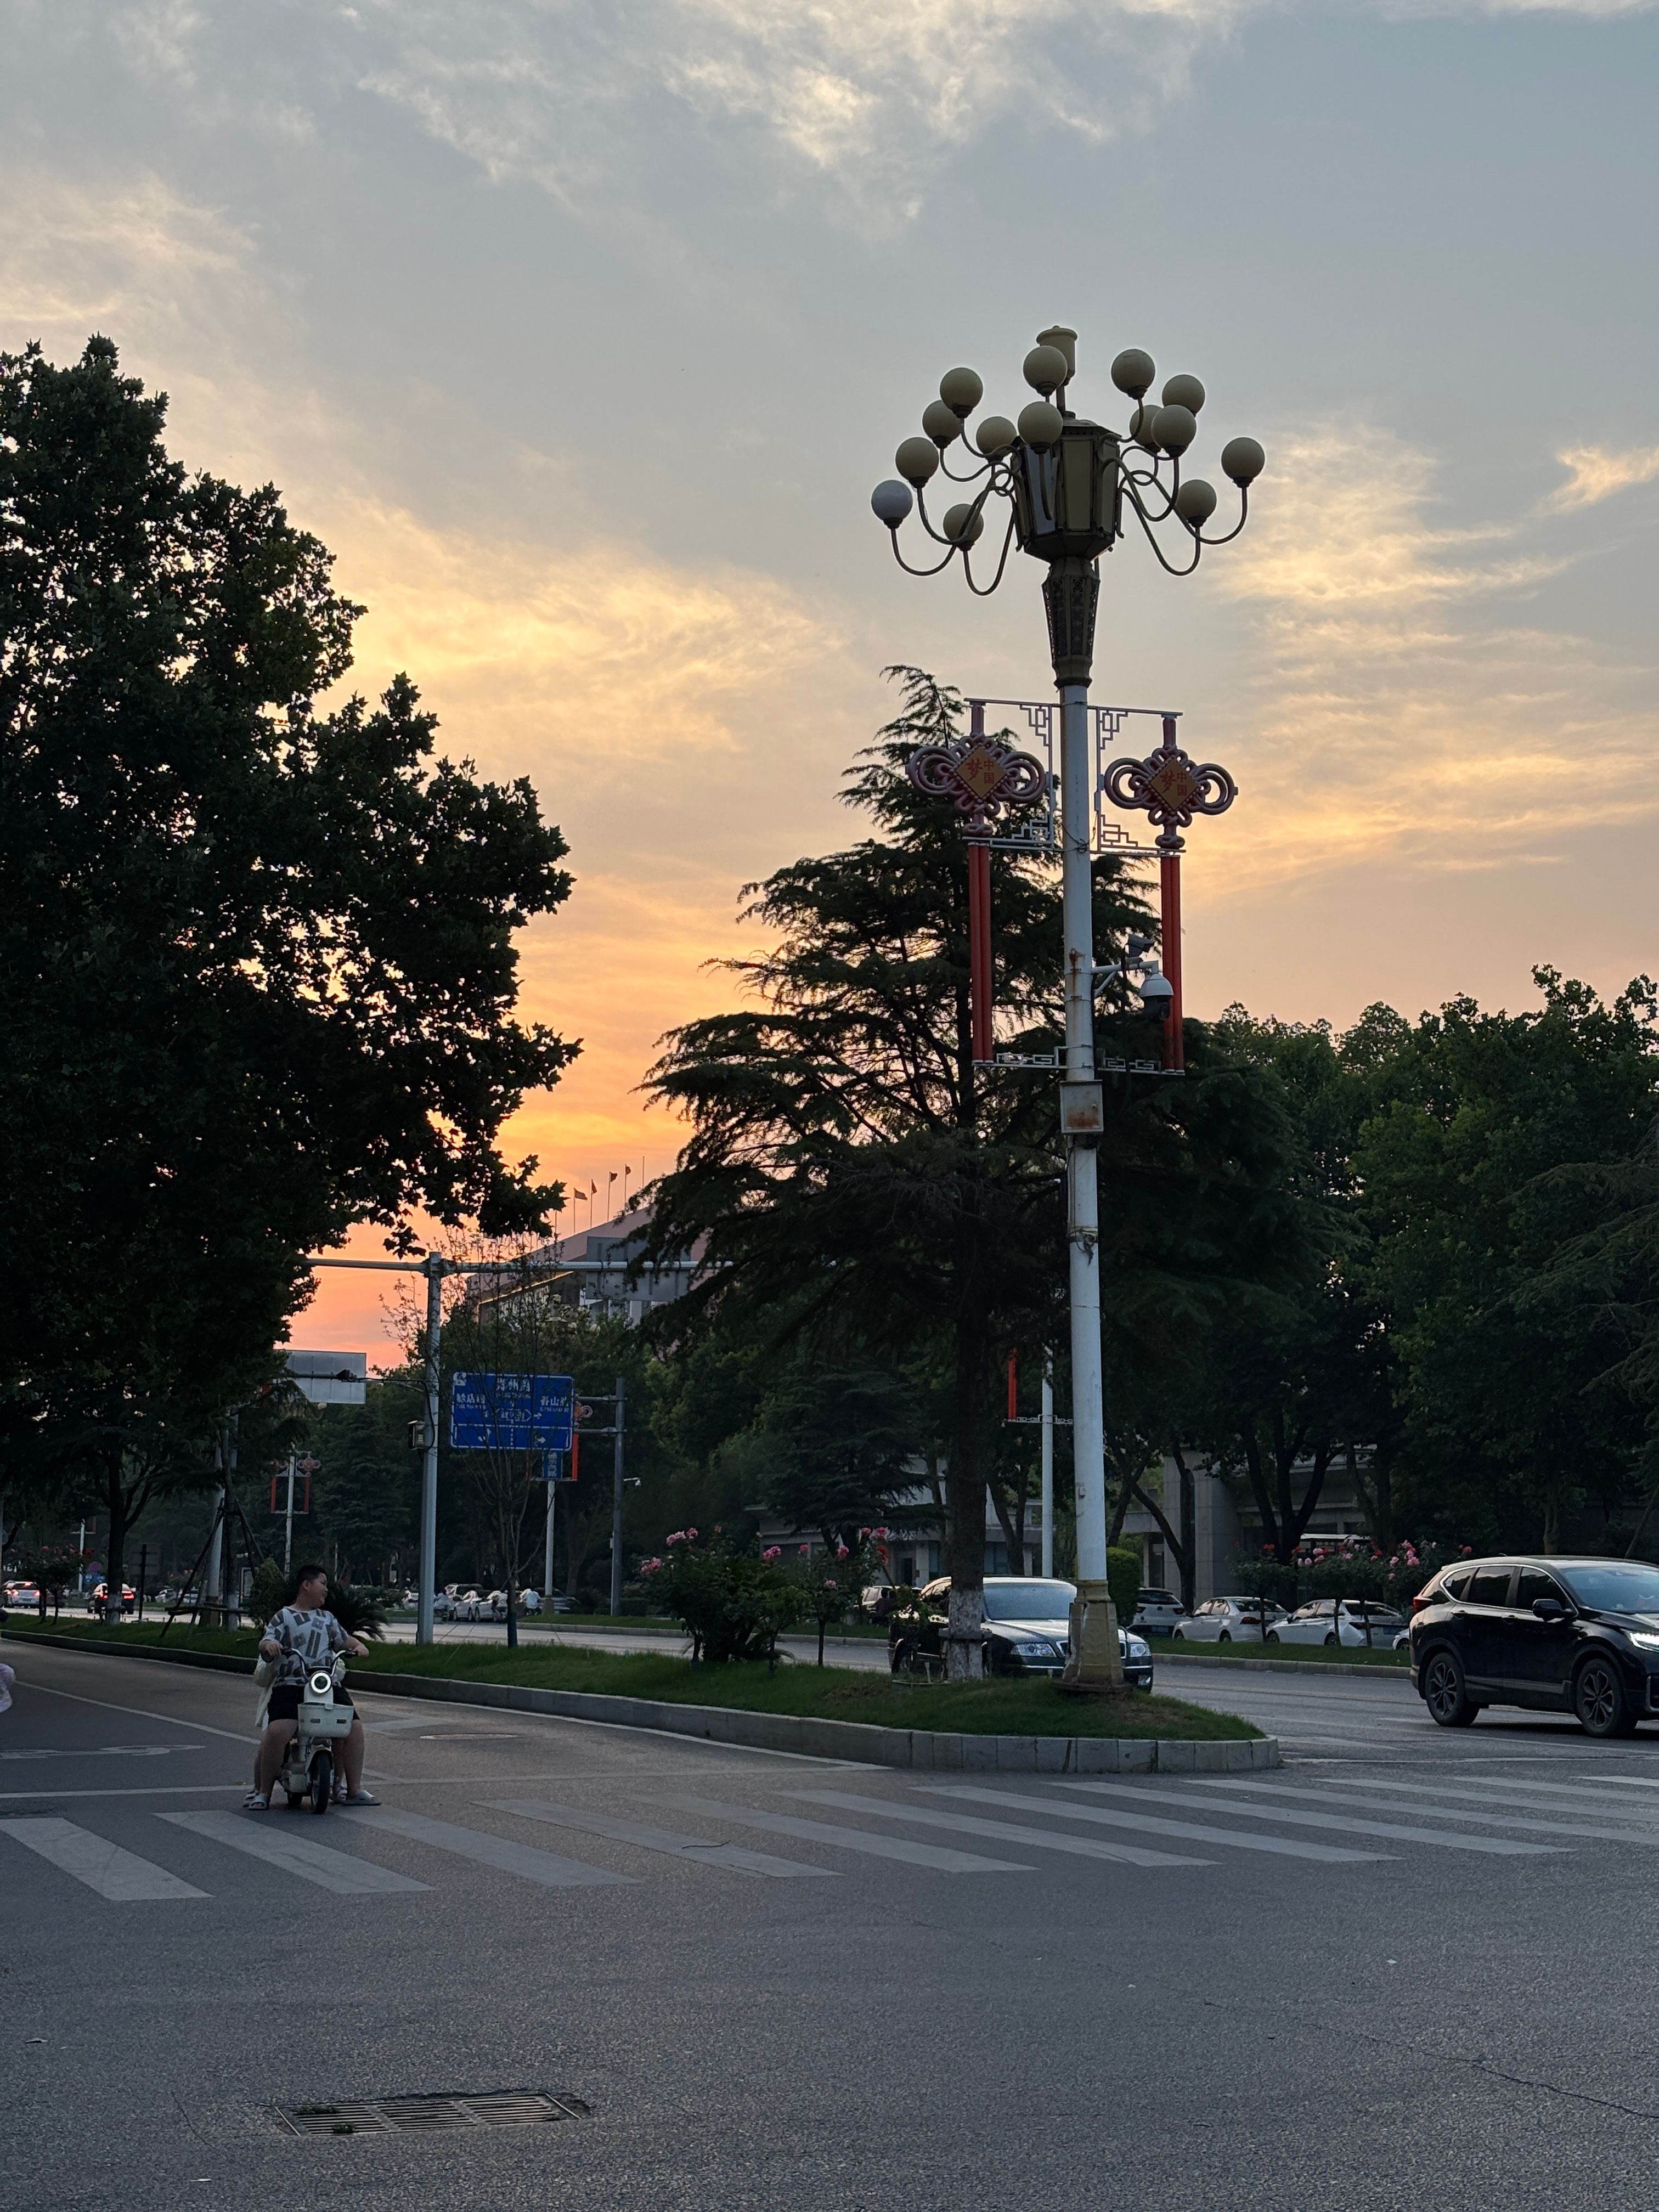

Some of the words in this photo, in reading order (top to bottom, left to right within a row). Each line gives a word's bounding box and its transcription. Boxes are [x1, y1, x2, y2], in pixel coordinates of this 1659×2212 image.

[966, 758, 983, 781] 梦
[984, 758, 995, 784] 中国
[1160, 770, 1176, 793] 梦
[1177, 771, 1187, 797] 中国
